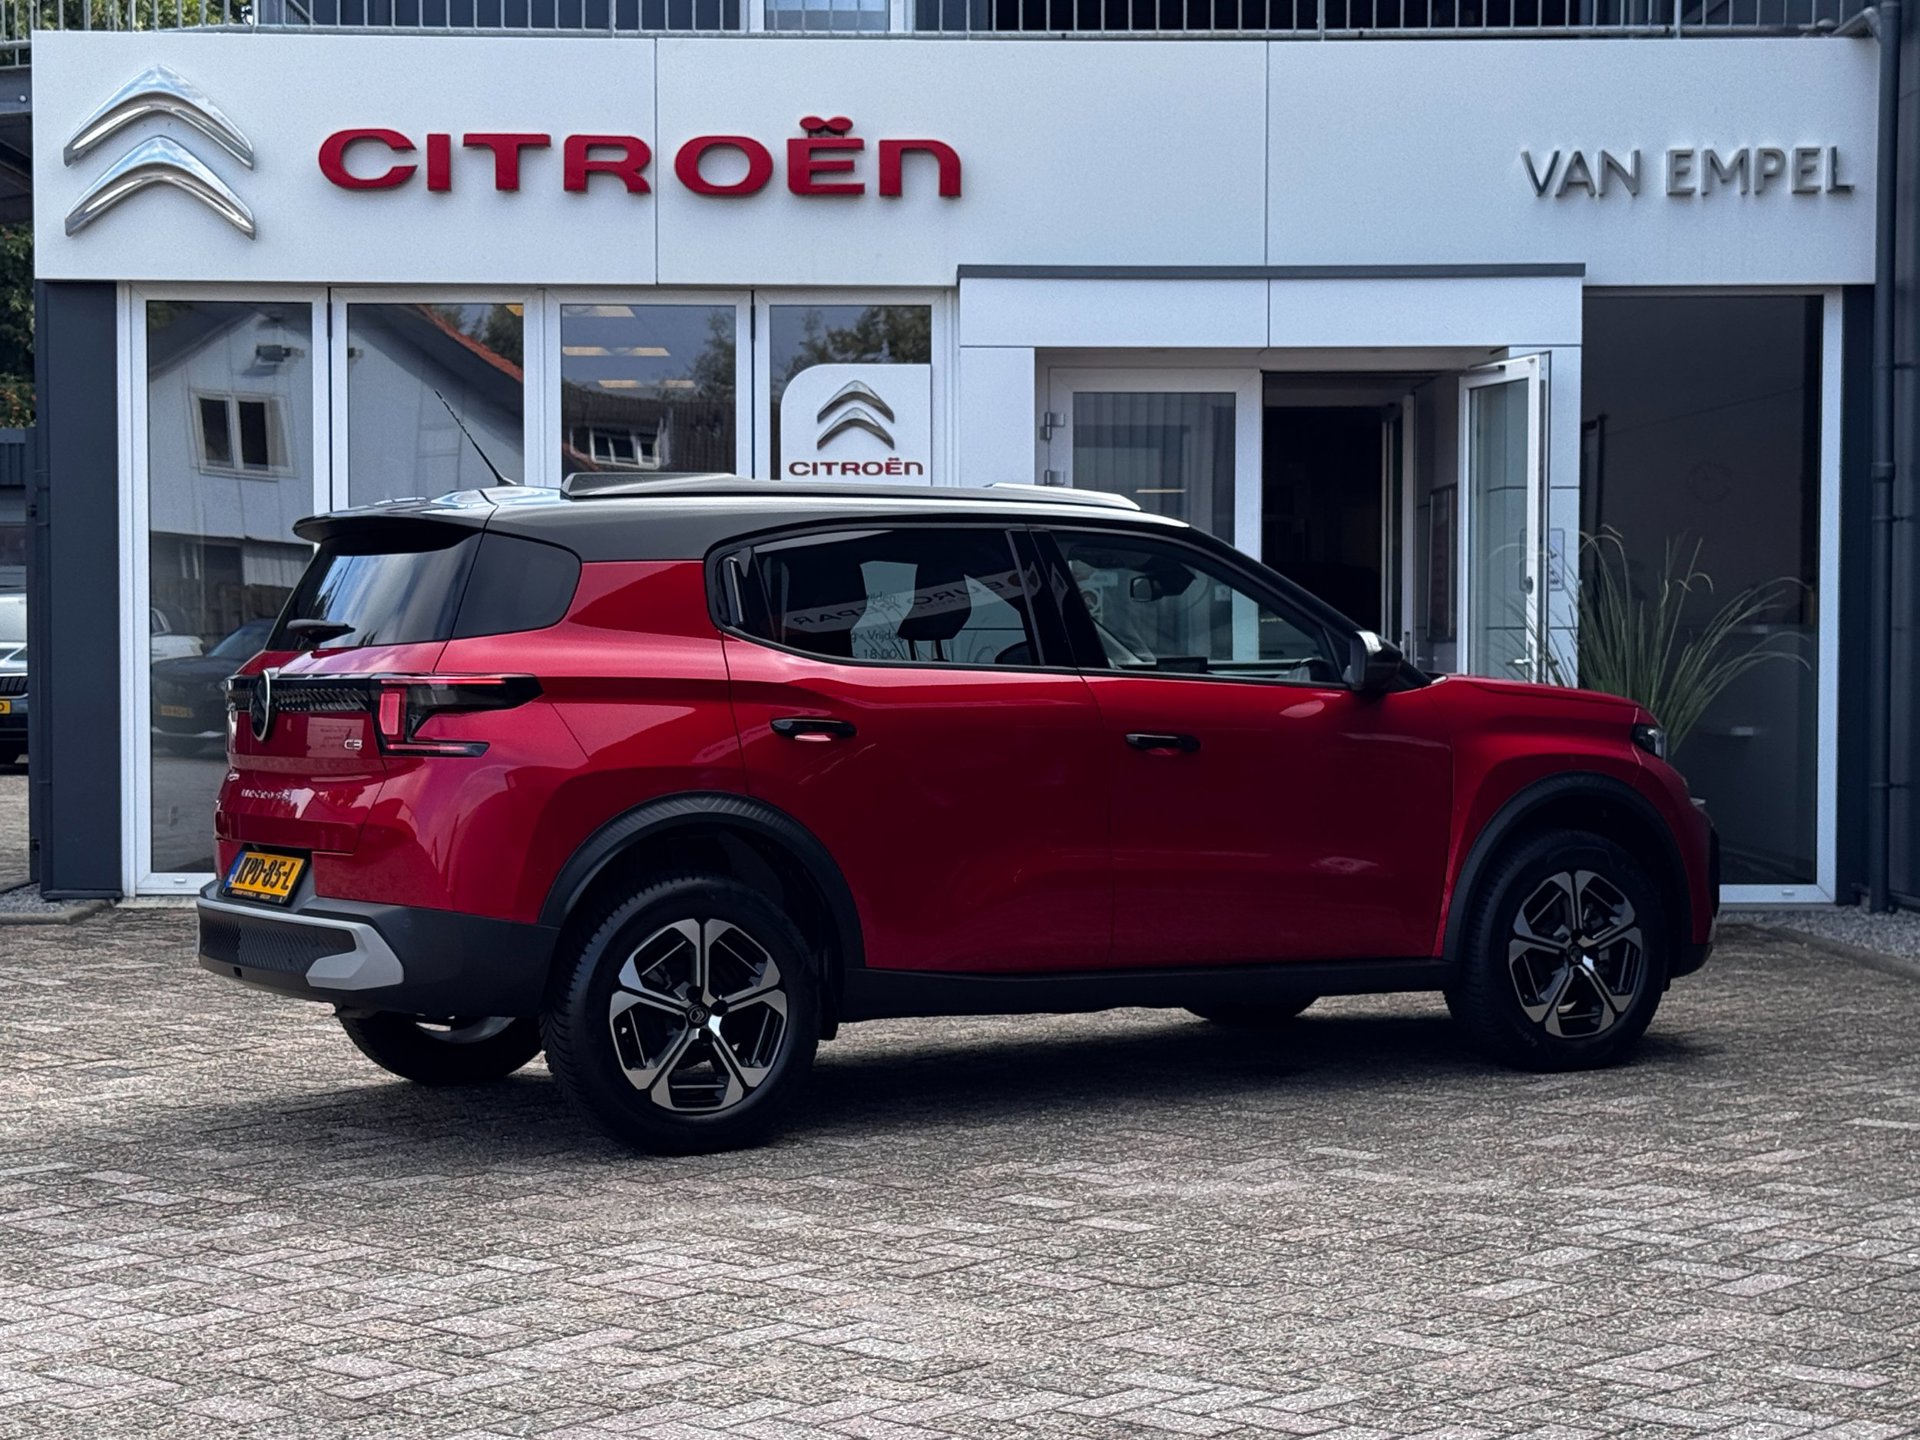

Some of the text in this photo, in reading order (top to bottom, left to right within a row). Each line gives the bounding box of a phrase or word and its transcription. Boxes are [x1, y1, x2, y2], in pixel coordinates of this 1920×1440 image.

[1520, 146, 1856, 198] VAN EMPEL
[344, 739, 363, 750] C3
[235, 857, 296, 890] KPD-85-L
